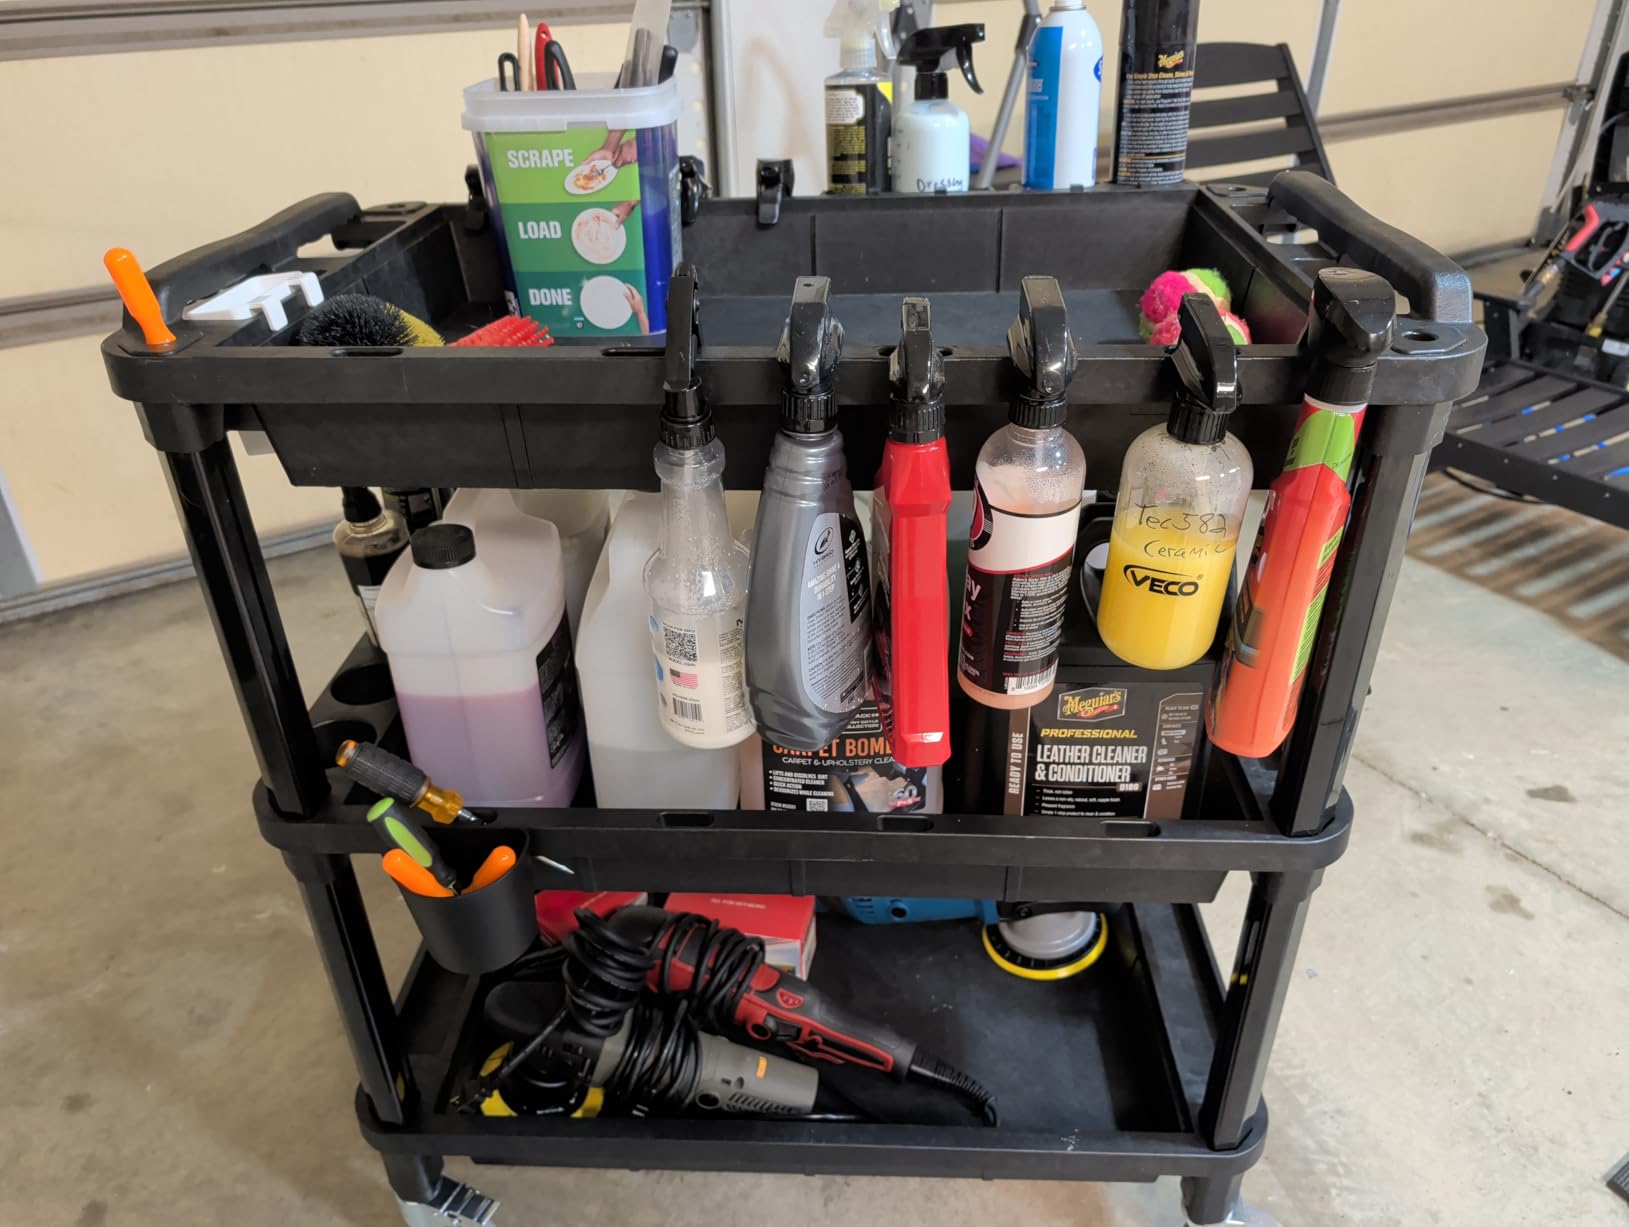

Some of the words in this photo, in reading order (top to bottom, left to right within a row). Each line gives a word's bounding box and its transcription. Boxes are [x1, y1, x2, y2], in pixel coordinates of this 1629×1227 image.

[507, 149, 574, 169] SCRAPE
[518, 221, 562, 240] LOAD
[528, 288, 573, 306] DONE
[1129, 569, 1199, 596] VECO
[1062, 690, 1122, 716] Meguiar's
[1011, 732, 1023, 750] USE
[1040, 728, 1138, 739] PROFESSIONAL
[782, 757, 812, 765] CARPET
[822, 758, 873, 767] UPHOLSTERY
[874, 757, 896, 765] CLEA
[1011, 752, 1022, 764] TO
[1036, 744, 1090, 763] LEATHER
[1092, 745, 1148, 764] CLEANER
[1008, 766, 1022, 795] READY
[1035, 764, 1046, 781] &
[1049, 764, 1131, 783] CONDITIONER
